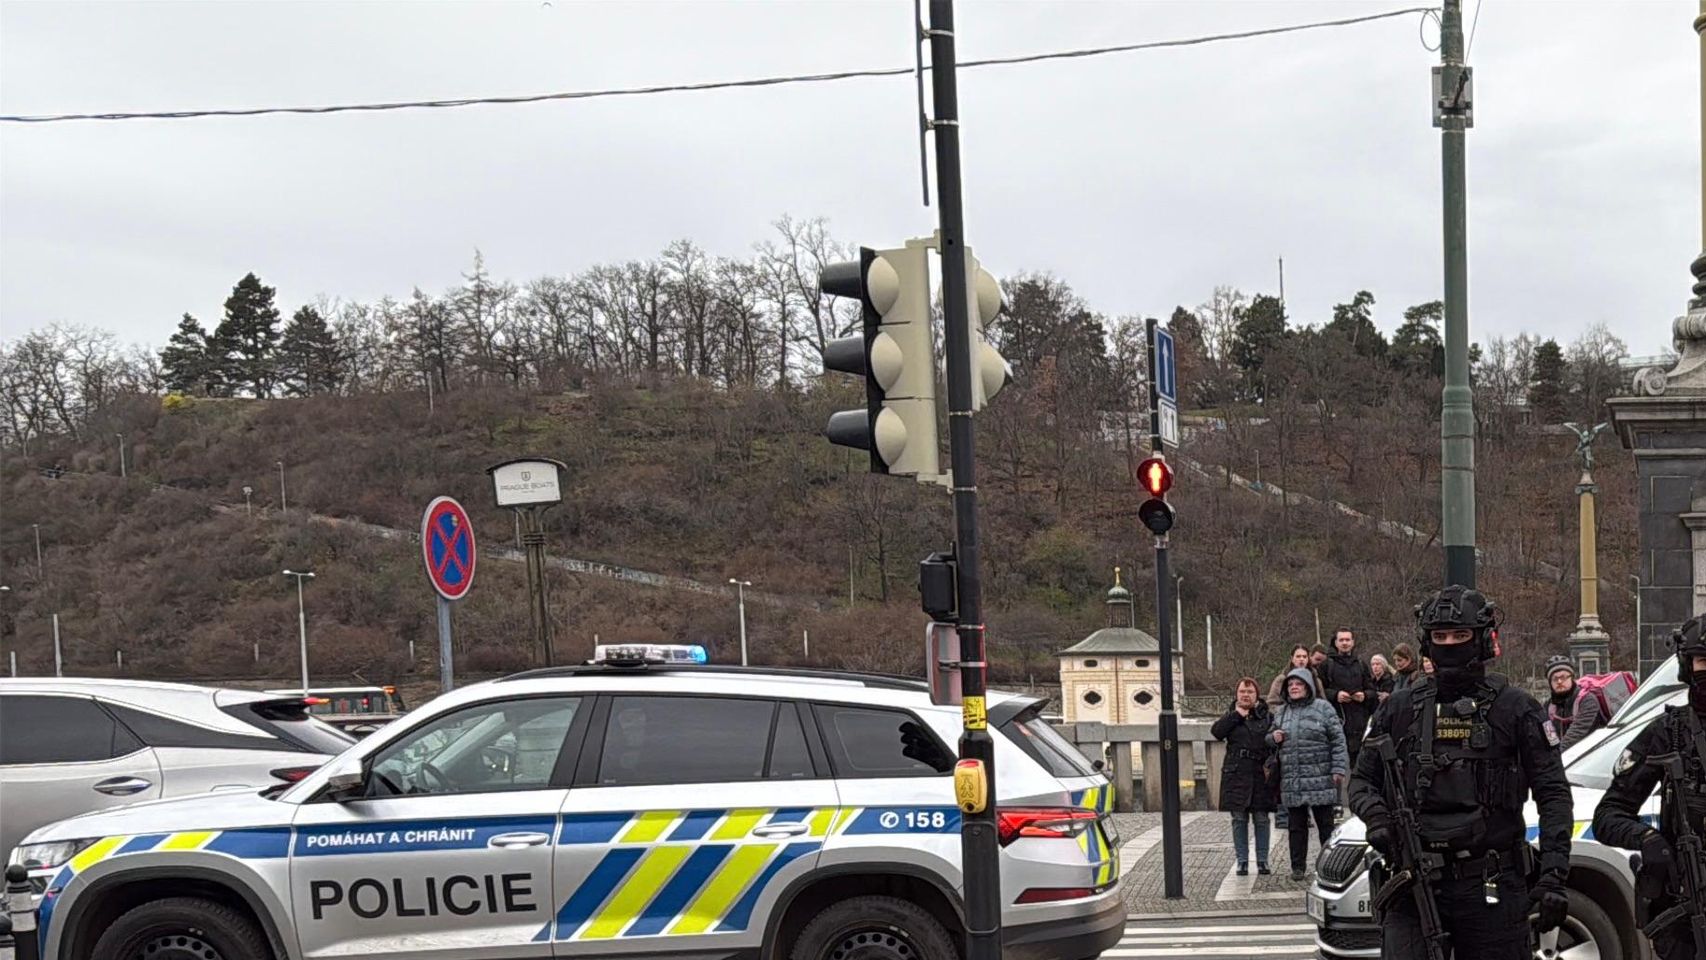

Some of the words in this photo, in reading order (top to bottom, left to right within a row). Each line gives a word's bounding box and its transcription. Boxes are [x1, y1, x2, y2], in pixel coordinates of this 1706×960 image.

[1436, 728, 1471, 739] 338050
[904, 811, 946, 828] 158
[306, 828, 385, 848] POMÁHAT
[388, 831, 401, 843] A
[404, 826, 476, 844] CHRÁNIT
[310, 872, 537, 920] POLICIE
